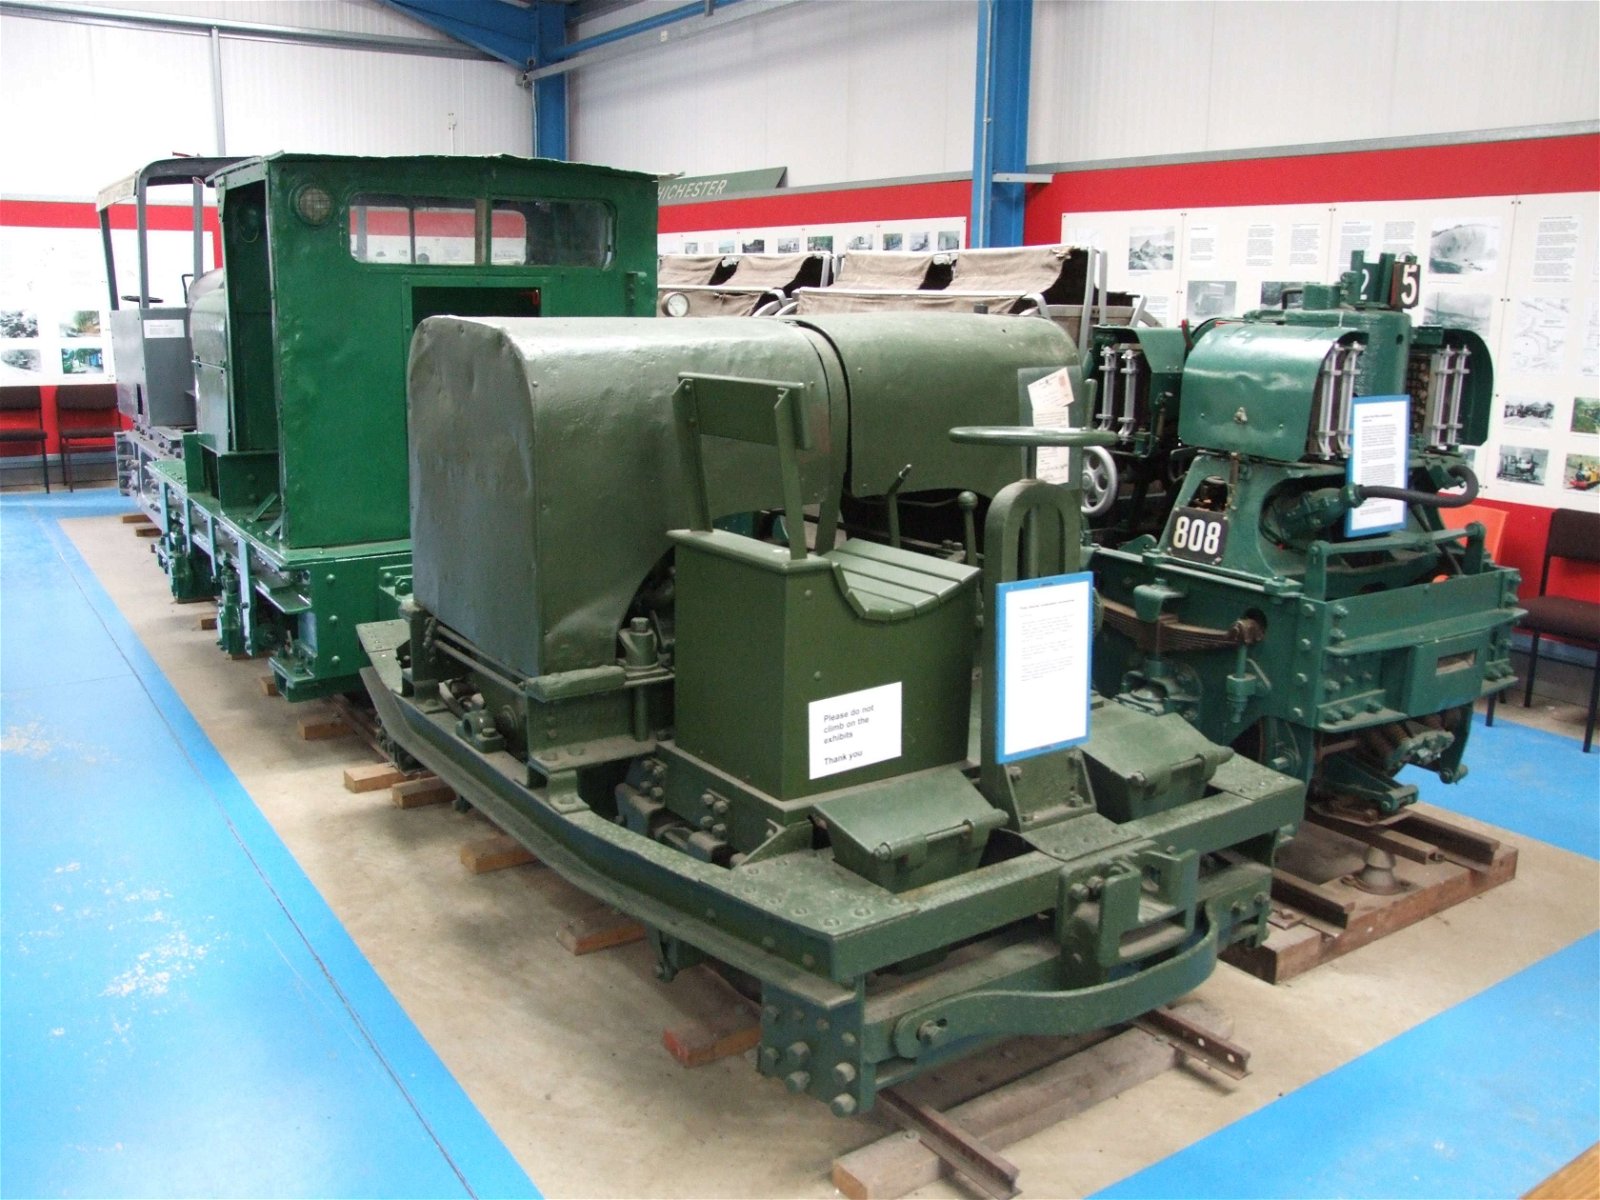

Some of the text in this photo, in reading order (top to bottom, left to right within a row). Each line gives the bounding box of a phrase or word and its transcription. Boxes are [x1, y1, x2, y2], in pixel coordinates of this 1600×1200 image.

[658, 180, 728, 200] HICHESTER
[1401, 264, 1418, 305] 5
[1173, 516, 1221, 555] 808
[823, 711, 848, 722] Please
[862, 704, 874, 712] not
[823, 716, 870, 733] climb on the
[823, 731, 854, 744] exhibits
[823, 750, 862, 765] Thank you
